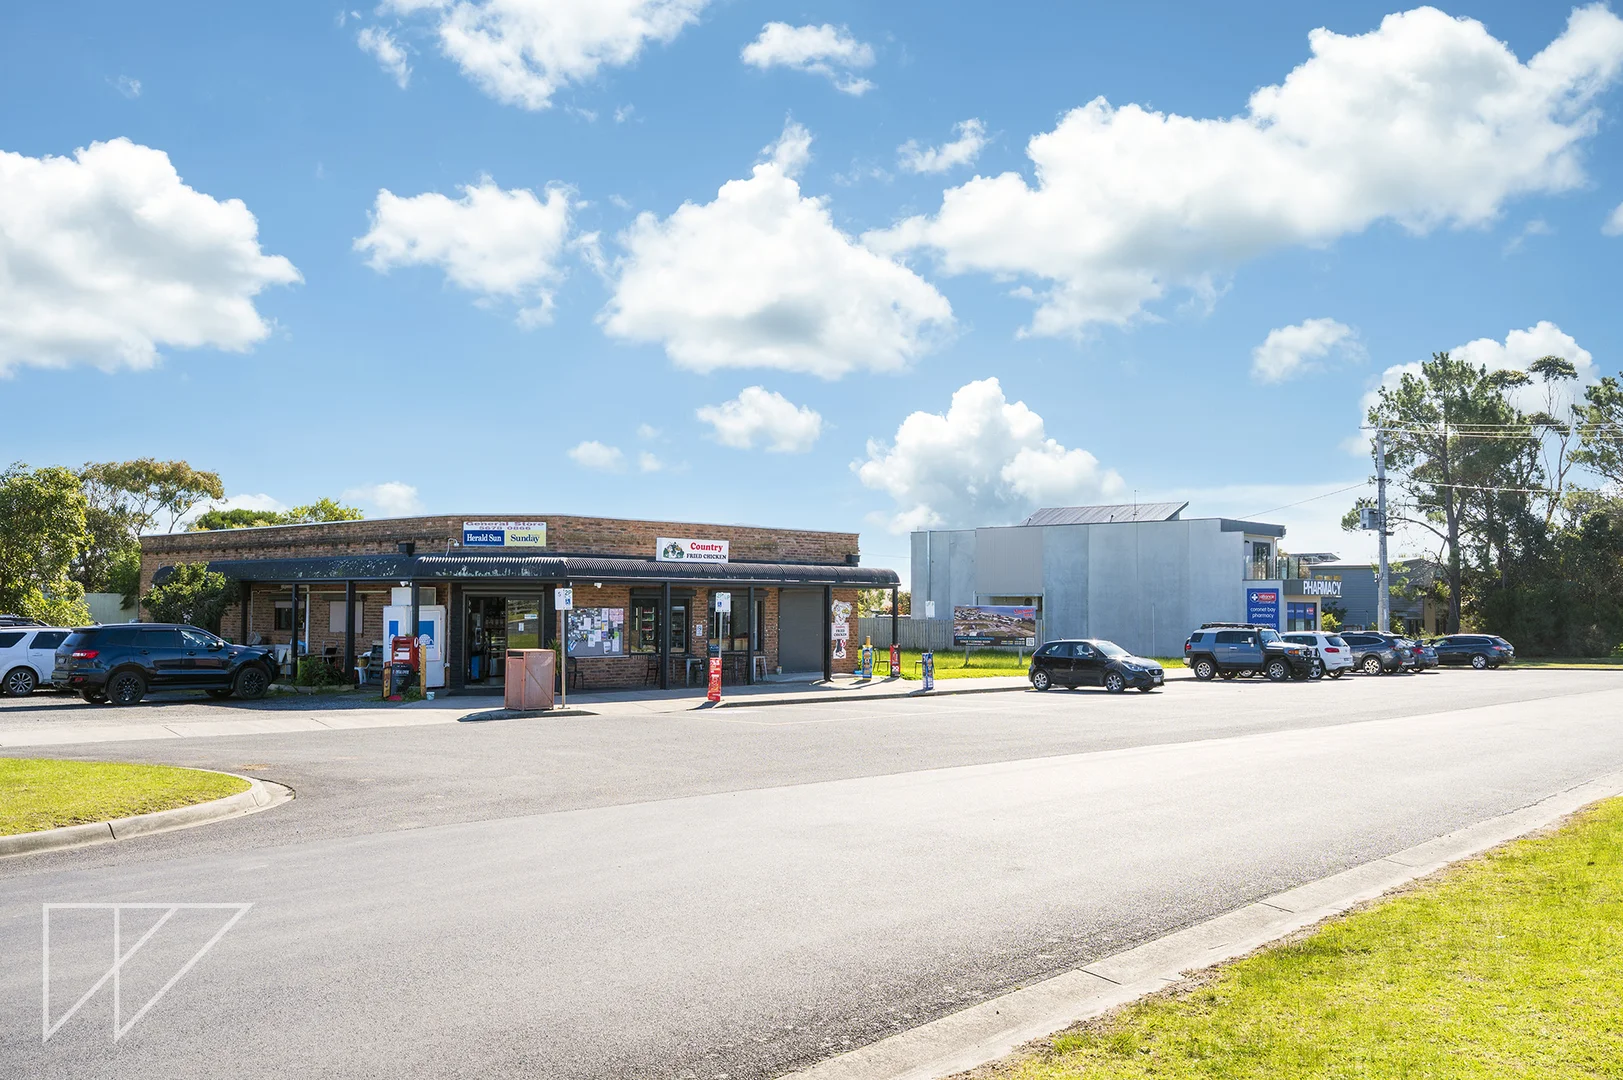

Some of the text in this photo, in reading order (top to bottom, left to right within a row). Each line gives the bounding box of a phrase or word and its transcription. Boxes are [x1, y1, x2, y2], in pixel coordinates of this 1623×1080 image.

[466, 534, 502, 542] Herald Sun
[510, 534, 540, 543] Sunday
[690, 542, 723, 552] Country
[1303, 580, 1342, 595] PHARMACY
